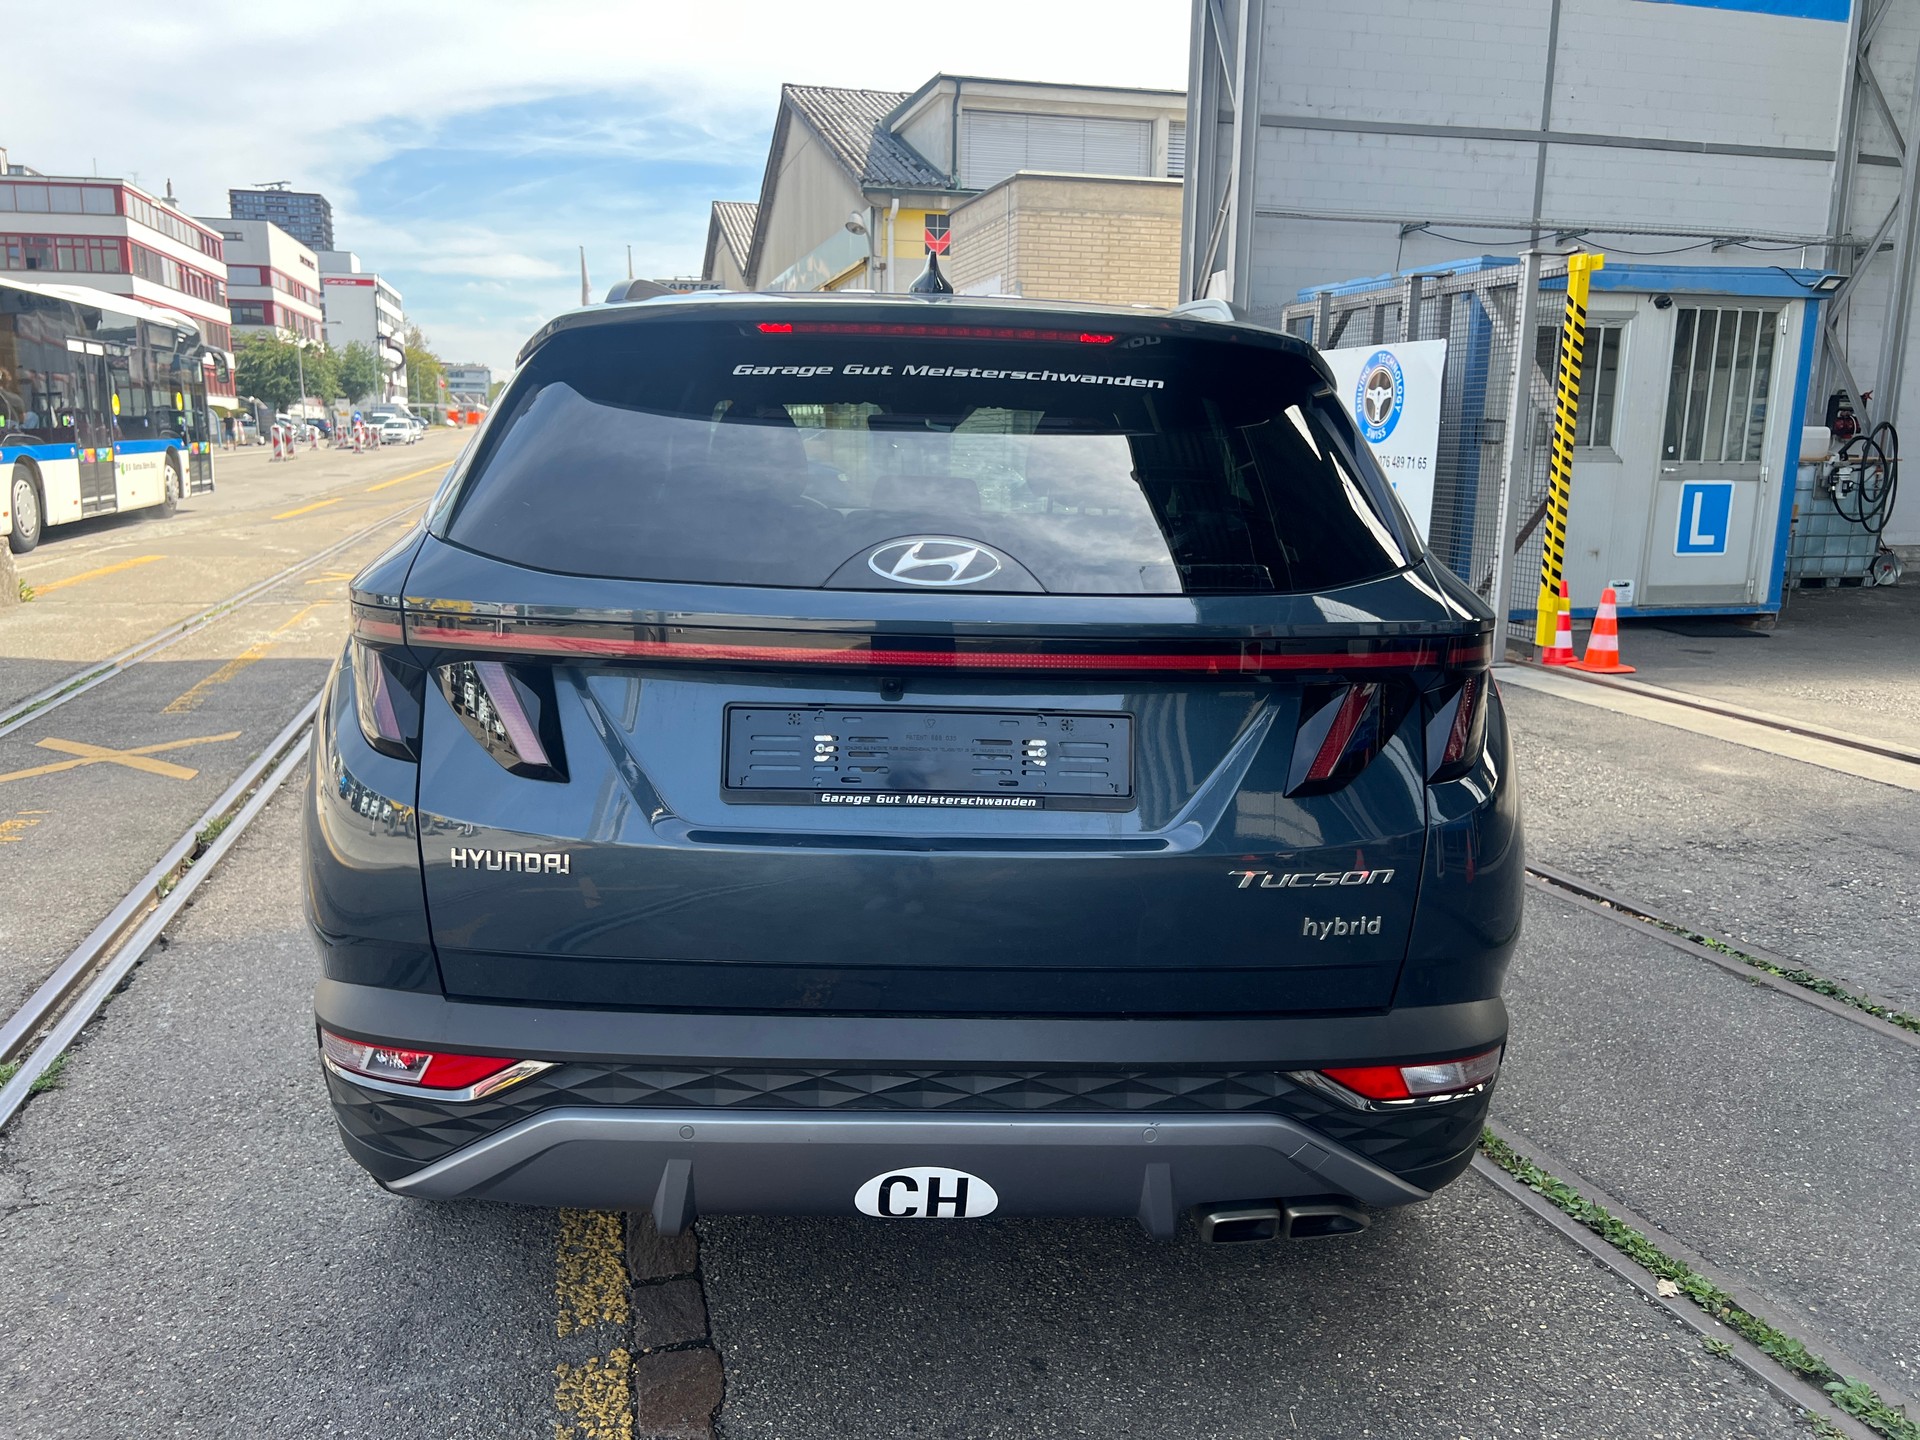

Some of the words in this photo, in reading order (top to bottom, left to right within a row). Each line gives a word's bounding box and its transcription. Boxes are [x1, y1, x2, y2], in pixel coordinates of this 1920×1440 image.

[660, 282, 721, 291] ARTEK
[732, 363, 834, 378] Garage
[842, 363, 894, 377] Gut
[902, 363, 1165, 390] Meisterschwanden
[1356, 366, 1371, 413] DRIVING
[1377, 353, 1403, 413] TECHNOLOGY
[1365, 427, 1387, 440] SWISS
[1407, 456, 1416, 469] 71
[1417, 456, 1427, 470] 65
[1688, 491, 1715, 546] L
[820, 793, 872, 806] Garage
[876, 794, 901, 806] Gut
[905, 794, 1037, 808] Meisterschwanden
[450, 847, 570, 875] HYUNDAI
[1302, 915, 1382, 941] hybrid
[878, 1175, 969, 1218] CH
